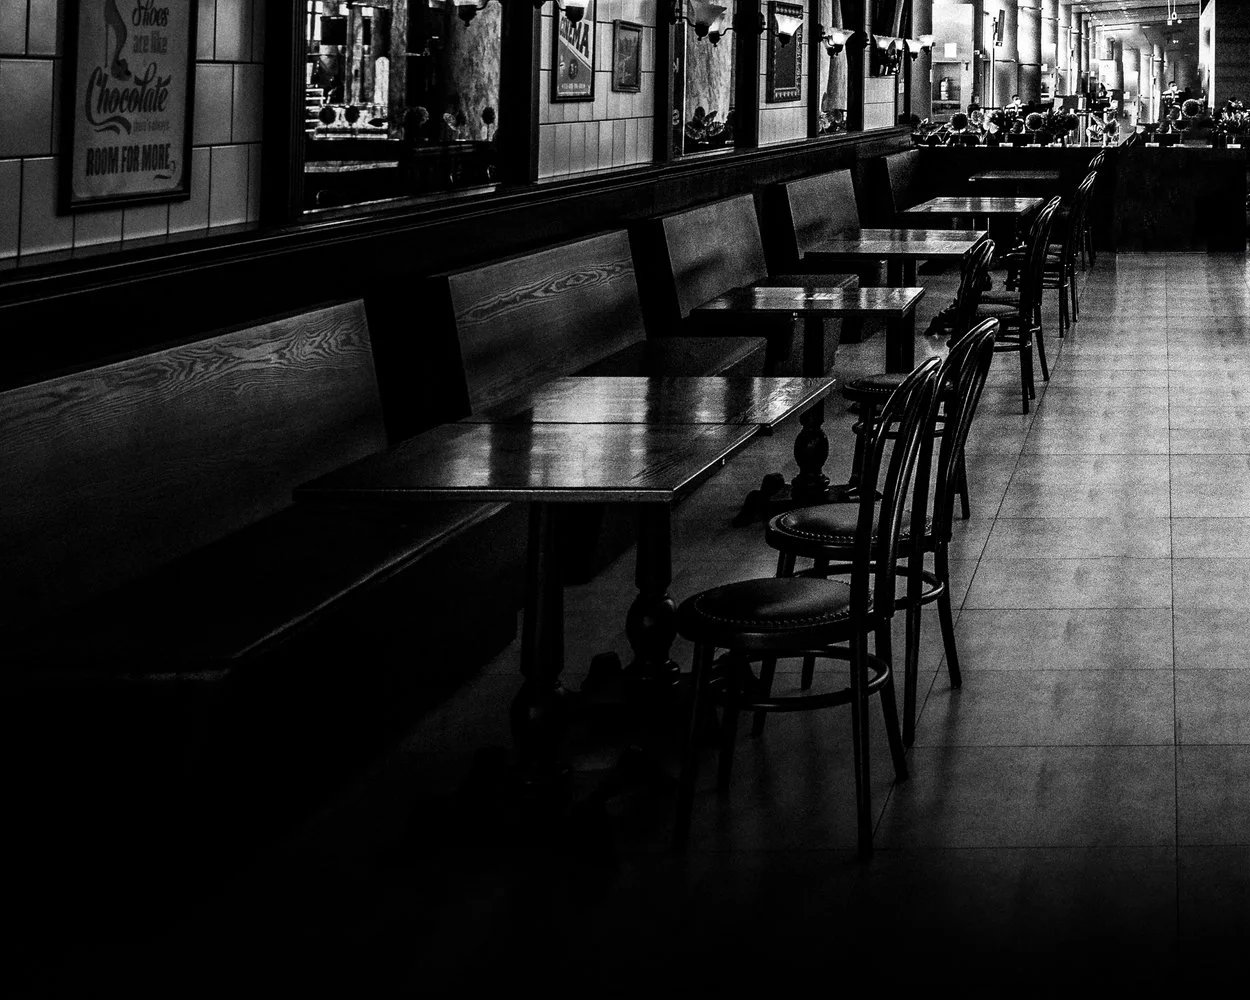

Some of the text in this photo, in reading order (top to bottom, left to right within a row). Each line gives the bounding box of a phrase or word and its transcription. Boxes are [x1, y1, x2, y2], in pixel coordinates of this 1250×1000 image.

[133, 30, 168, 54] are like
[85, 62, 172, 126] Chocolate
[86, 143, 171, 176] ROOM FOR MORE
